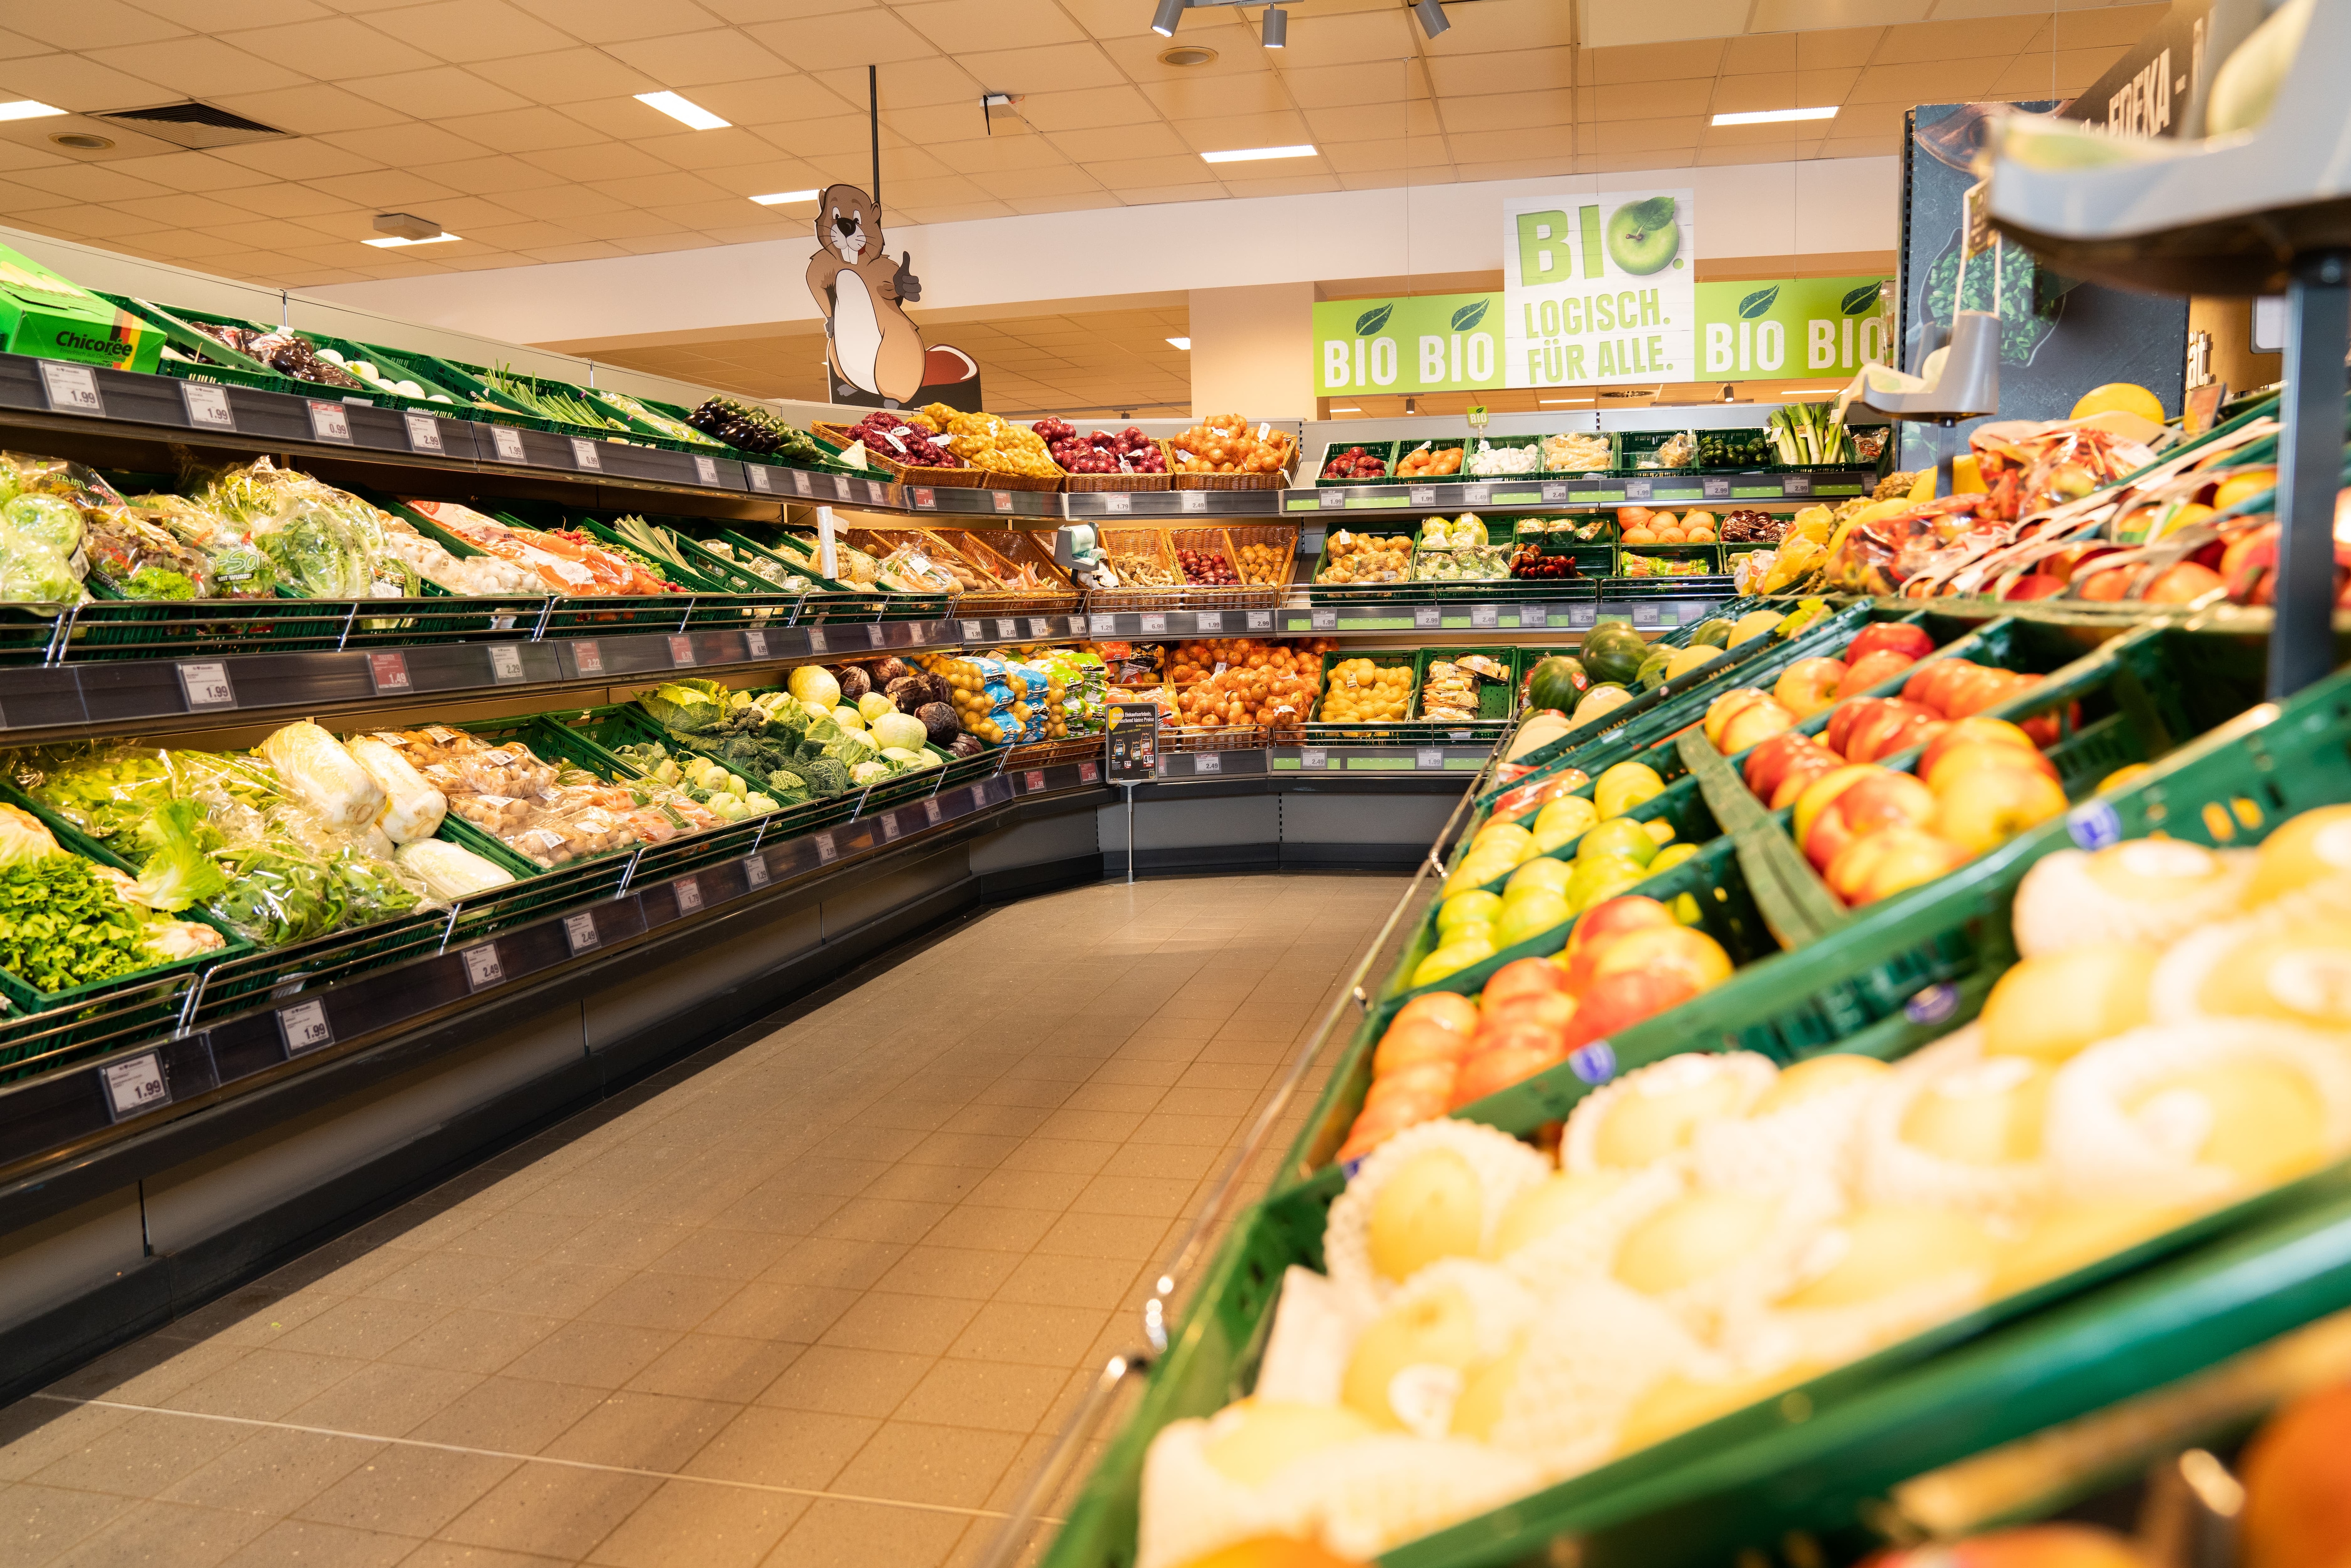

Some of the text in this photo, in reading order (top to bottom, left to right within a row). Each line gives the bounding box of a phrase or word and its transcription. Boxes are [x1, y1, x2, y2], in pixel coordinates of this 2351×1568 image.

[1524, 288, 1671, 339] LOGISCH.
[55, 331, 133, 357] Chicorée
[1706, 317, 1885, 372] BIO BIO
[66, 357, 113, 368] www.chico-ree.de
[96, 352, 126, 362] Deutschland
[1324, 332, 1494, 388] BIO BIO
[1528, 335, 1673, 385] FÜR ALLE.
[2186, 331, 2210, 390] ät.
[71, 390, 95, 403] 1.99
[207, 408, 228, 420] 1.99
[1470, 412, 1487, 424] BIO
[330, 424, 347, 434] 0.99
[424, 435, 439, 445] 2.99
[508, 446, 522, 456] 1.99
[587, 457, 598, 465] 0.99
[506, 664, 521, 674] 2.29
[587, 658, 601, 668] 2.22
[388, 672, 407, 684] 1.49
[206, 686, 228, 698] 1.99
[826, 847, 835, 857] 2.99
[756, 870, 767, 880] 1.29
[688, 894, 700, 903] 1.79
[582, 930, 596, 943] 2.49
[483, 963, 499, 977] 2.49
[304, 1023, 325, 1039] 1.99
[135, 1079, 161, 1099] 1.99
